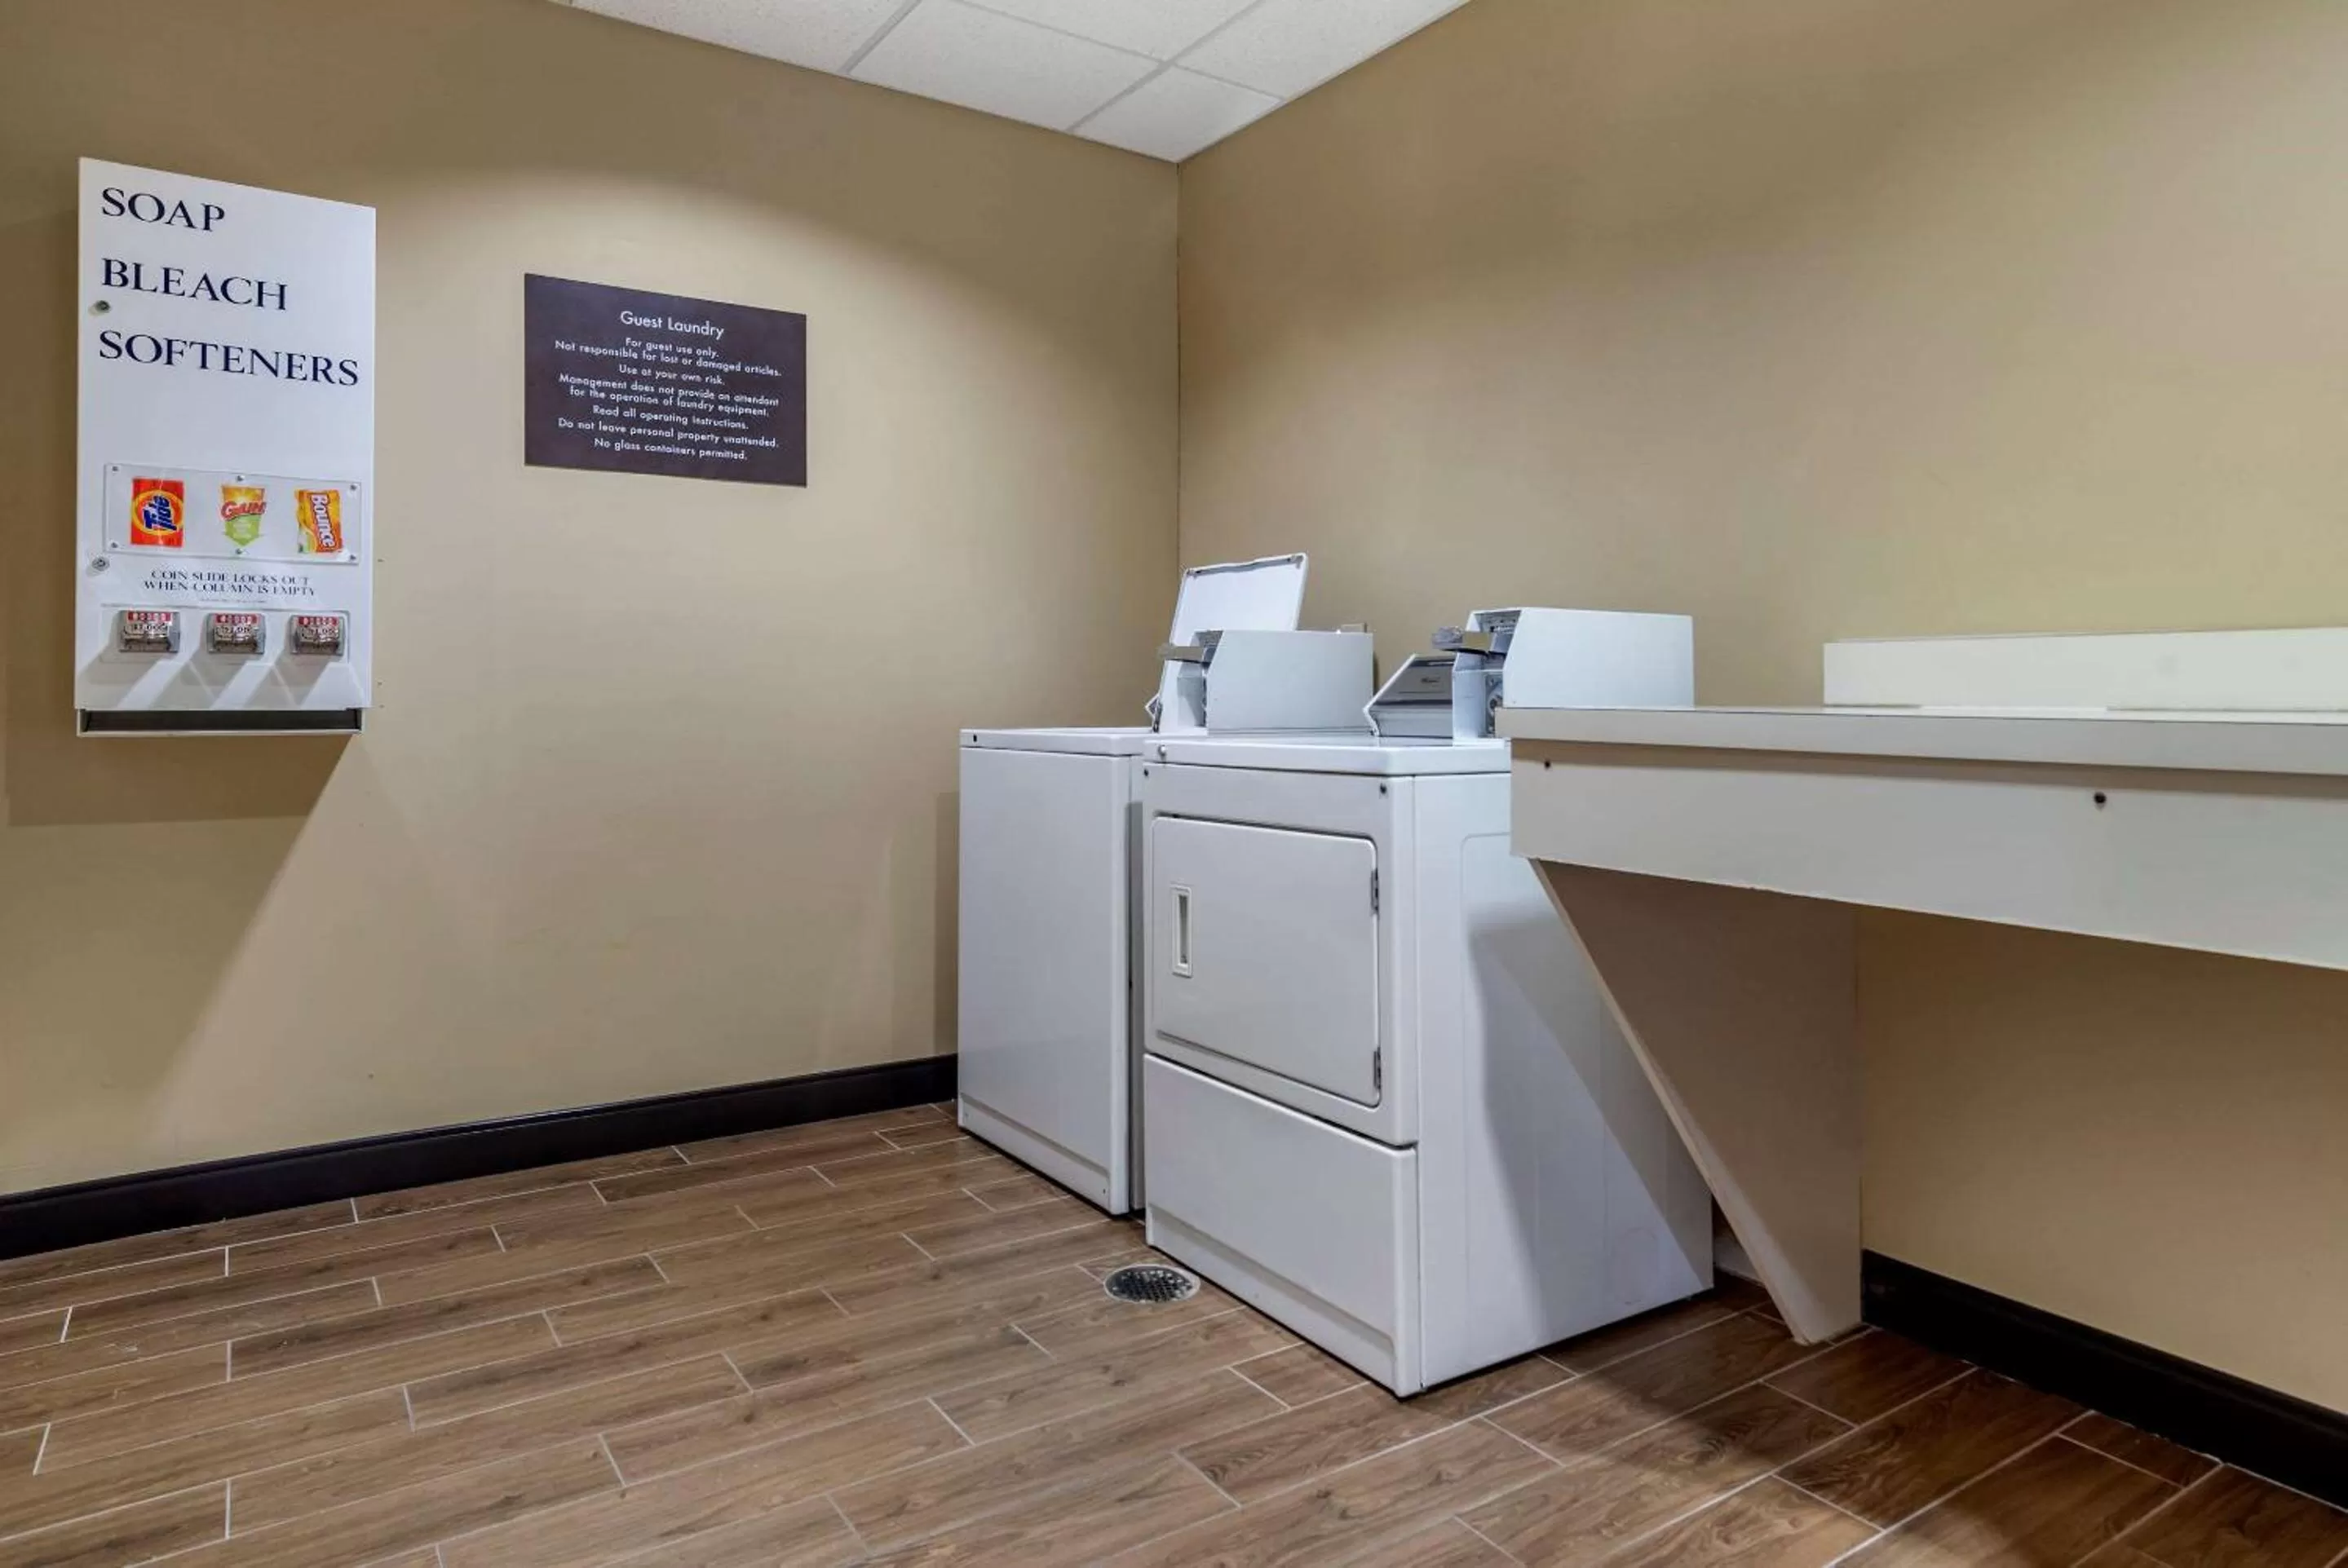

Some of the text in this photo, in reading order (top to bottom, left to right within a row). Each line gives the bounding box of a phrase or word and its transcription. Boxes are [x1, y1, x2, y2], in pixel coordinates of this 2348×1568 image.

[101, 187, 225, 232] SOAP
[101, 258, 287, 311] BLEACH
[620, 310, 724, 340] Guest Laundry
[99, 329, 359, 386] SOFTENERS
[555, 339, 782, 377] Not responsible for lost or damaged articles.
[625, 337, 719, 359] For guest use only.
[559, 373, 627, 389] Management
[630, 380, 655, 393] does
[678, 389, 715, 400] provide
[718, 393, 730, 401] an
[619, 364, 726, 386] Use at your own risk.
[569, 386, 585, 396] for
[589, 388, 606, 399] the
[609, 394, 659, 404] operation
[662, 395, 674, 406] of
[677, 396, 714, 413] laundry
[558, 417, 574, 428] Do
[577, 422, 595, 430] not
[598, 421, 626, 433] leave
[630, 426, 674, 438] personal
[678, 432, 719, 444] property
[592, 404, 750, 430] Read all operating instructions.
[594, 438, 748, 461] No glass containers permitted.
[143, 495, 178, 531] Tide
[311, 493, 335, 549] Bounce
[143, 581, 188, 591] WHEN
[150, 570, 188, 580] COIN
[233, 573, 278, 585] LOCKS
